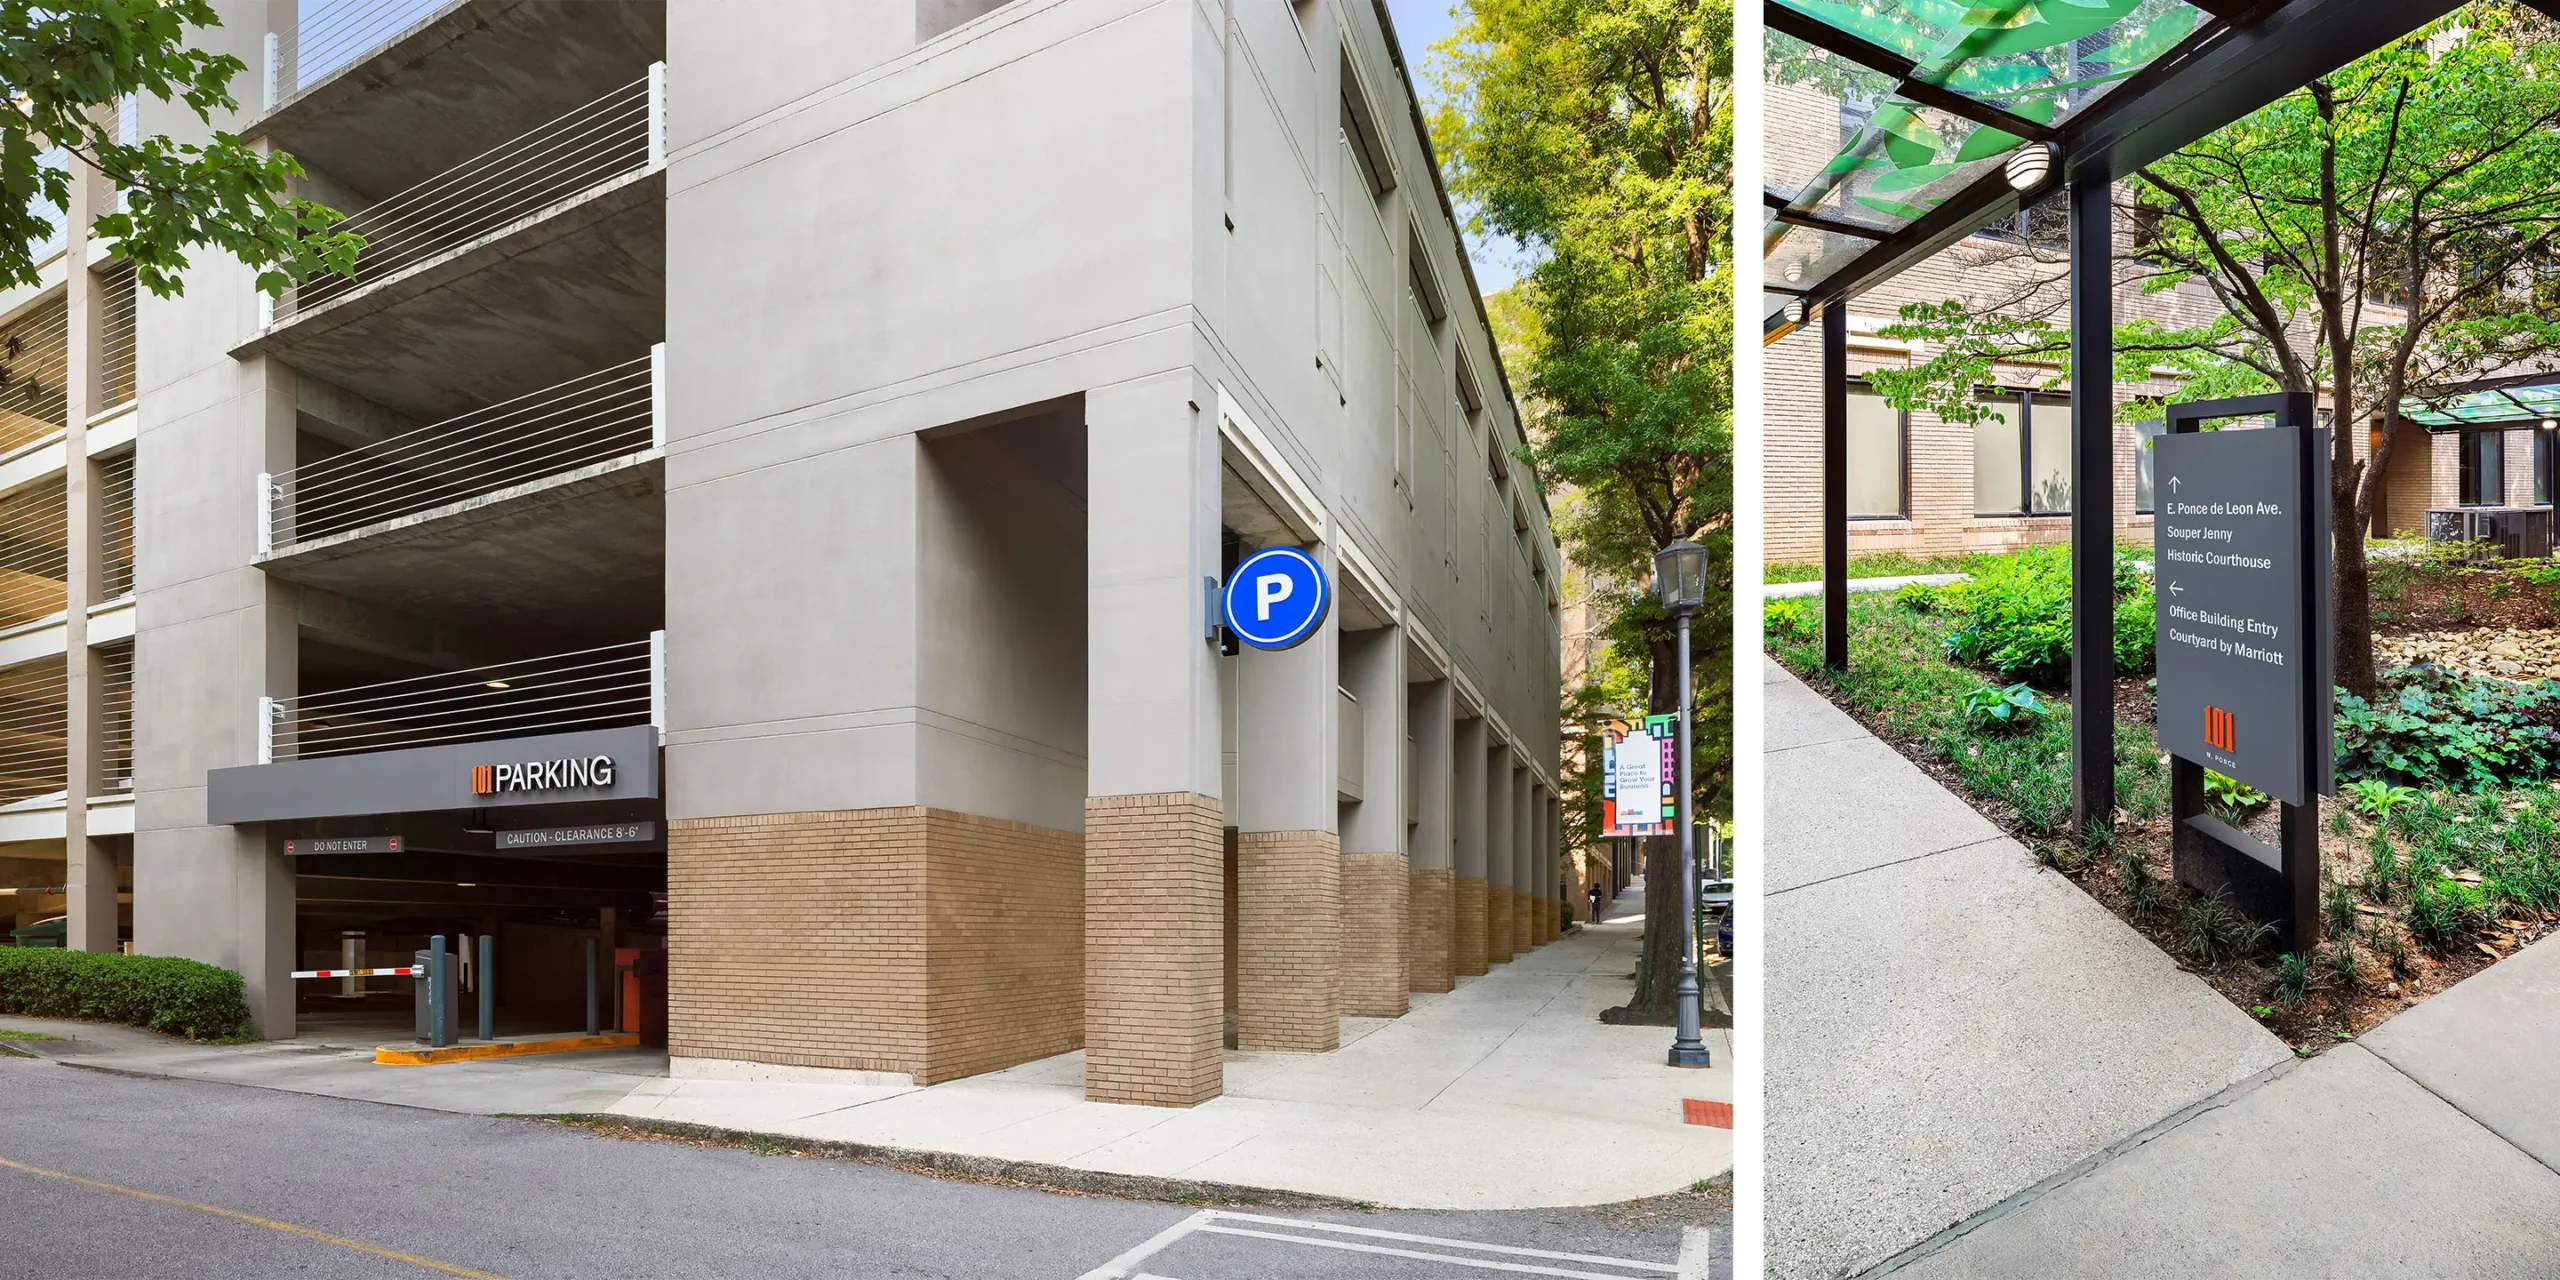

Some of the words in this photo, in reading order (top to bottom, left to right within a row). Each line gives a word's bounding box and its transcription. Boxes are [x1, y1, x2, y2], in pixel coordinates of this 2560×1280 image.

[2167, 503, 2176, 515] E.
[2178, 503, 2208, 515] Ponce
[2210, 502, 2224, 515] de
[2226, 502, 2254, 515] Leon
[2256, 501, 2282, 515] Ave.
[2167, 526, 2201, 541] Souper
[2202, 527, 2233, 543] Jenny
[2167, 549, 2204, 563] Historic
[2205, 551, 2272, 570] Courthouse
[1256, 573, 1294, 621] P
[2169, 605, 2198, 621] Office
[2200, 610, 2245, 633] Building
[2247, 618, 2278, 639] Entry
[2169, 628, 2217, 650] Courtyard
[2220, 639, 2232, 656] by
[2235, 642, 2284, 666] Marriott
[2204, 705, 2235, 753] 101
[2215, 754, 2237, 769] PONCE
[472, 765, 493, 794] 101
[496, 755, 612, 792] PARKING
[314, 842, 325, 851] DO
[326, 841, 342, 851] NOT
[343, 840, 367, 850] ENTER
[507, 832, 547, 845] CAUTION
[554, 827, 614, 842] CLEARANCE
[615, 826, 639, 839] 8'-6"
